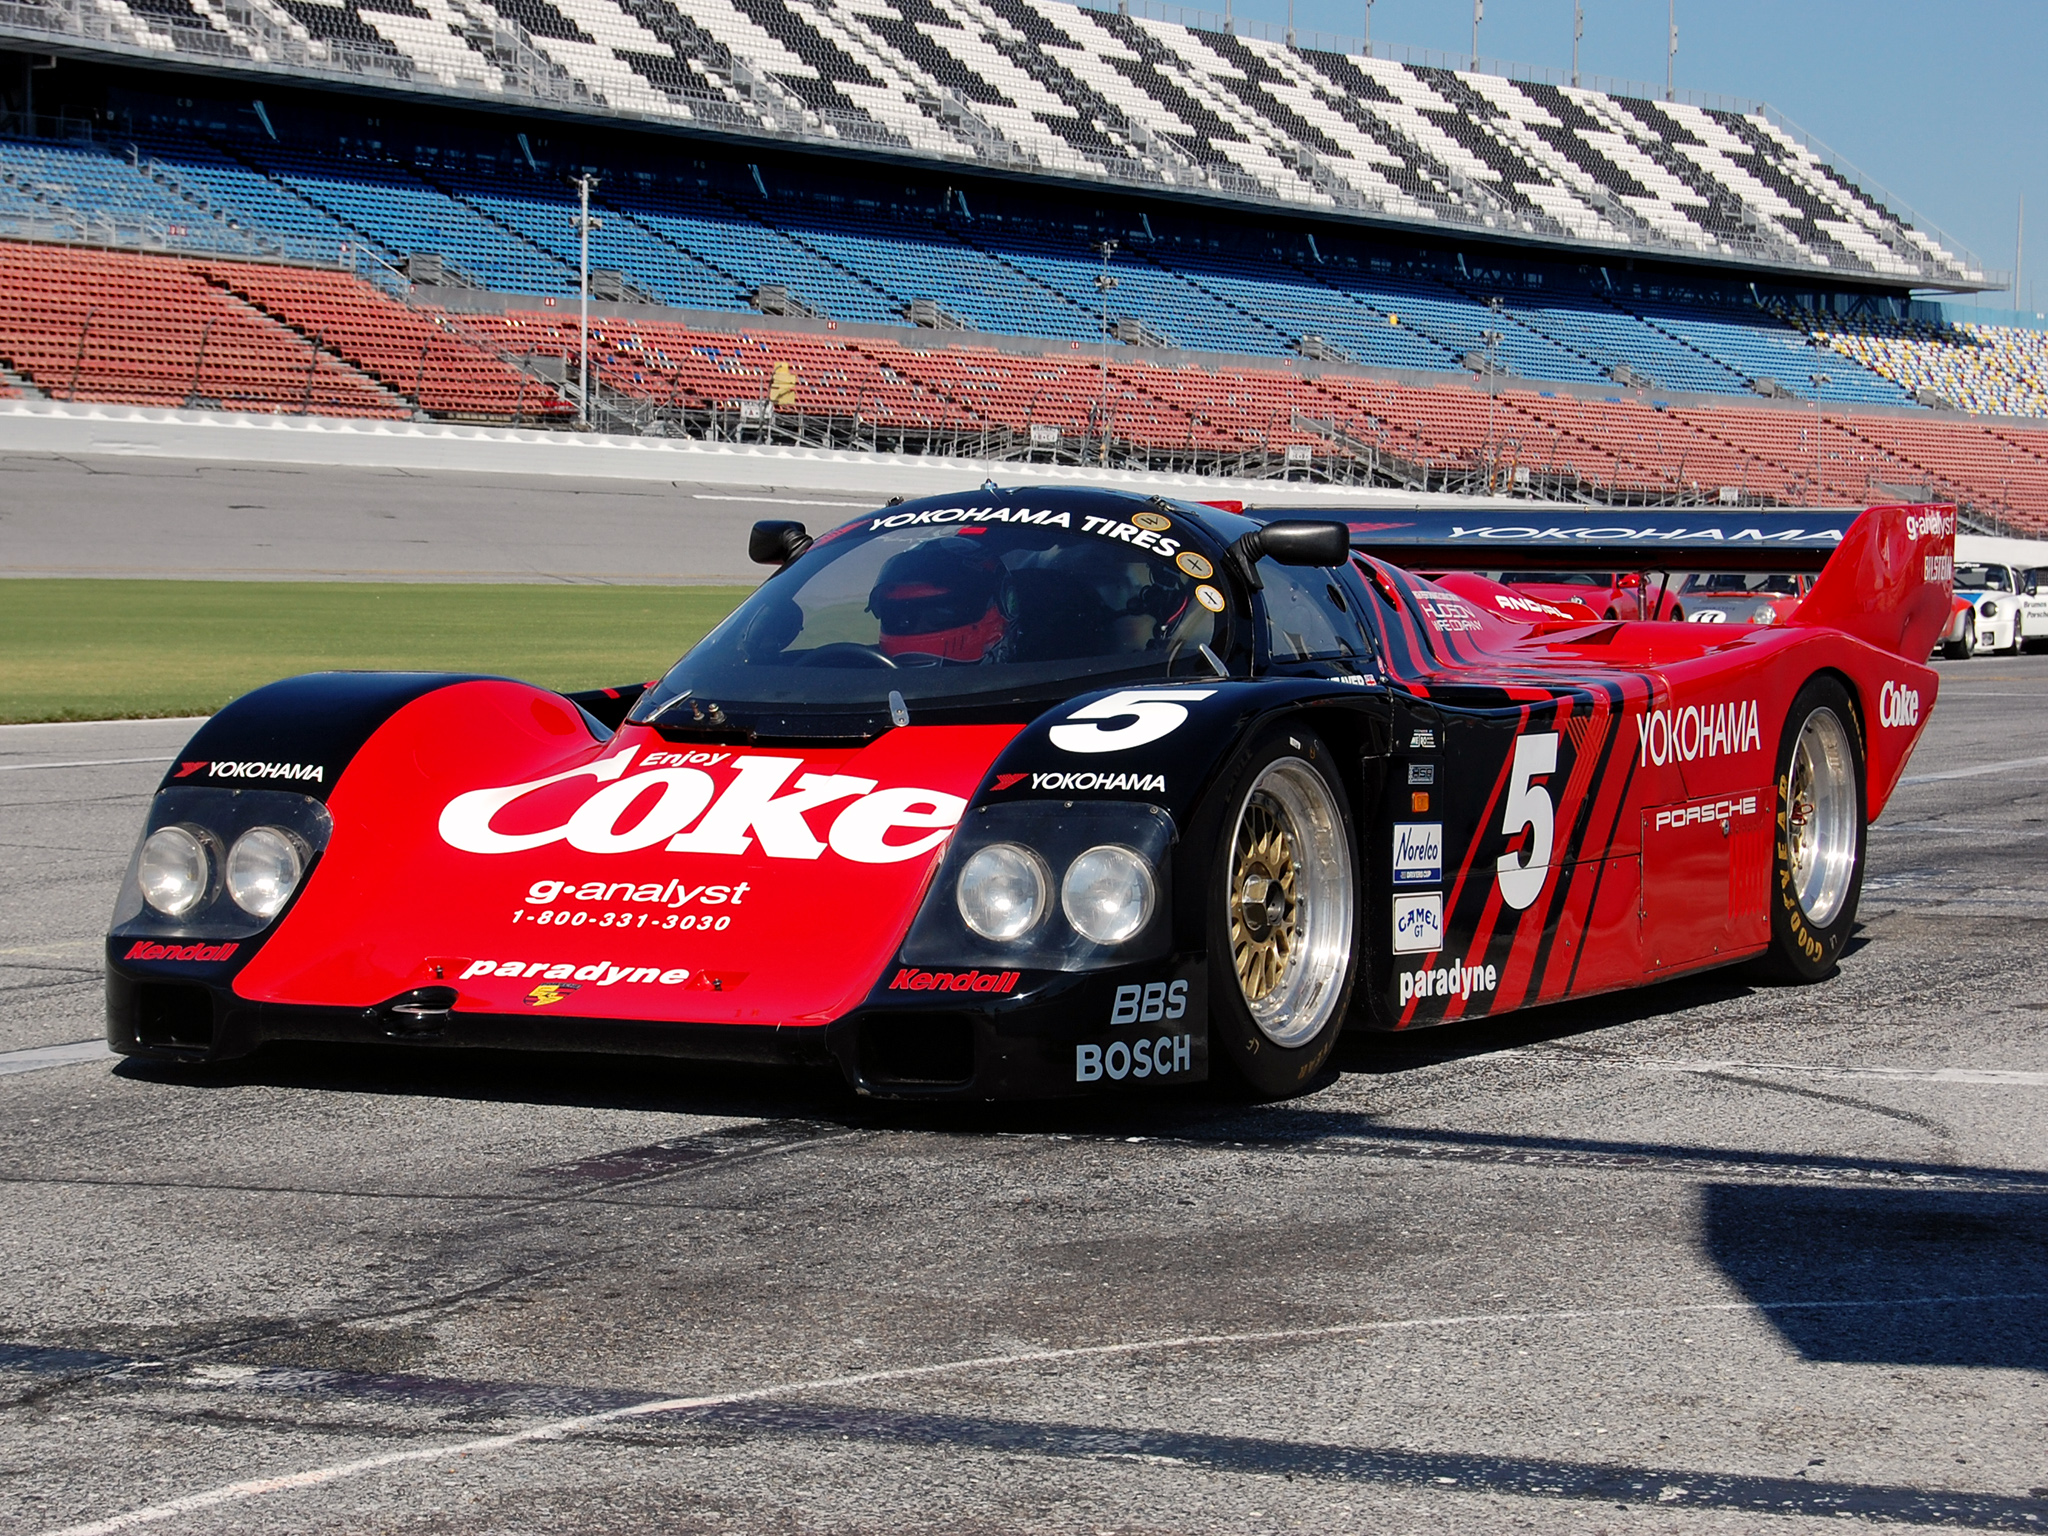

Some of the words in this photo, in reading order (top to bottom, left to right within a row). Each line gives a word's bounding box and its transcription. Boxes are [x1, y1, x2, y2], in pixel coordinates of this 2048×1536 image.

[869, 507, 1071, 531] YOKOHAMA
[1080, 515, 1181, 557] TIRES
[1447, 527, 1844, 540] YOKOHAMA
[1048, 689, 1219, 754] 5
[1879, 680, 1919, 728] Coke
[1636, 699, 1761, 767] YOKOHAMA
[208, 761, 324, 783] YOKOHAMA
[639, 750, 732, 767] Enjoy
[1030, 771, 1166, 792] YOKOHAMA
[438, 745, 969, 863] Coke
[1496, 732, 1559, 910] 5
[1655, 796, 1757, 831] PORSCHE
[1396, 827, 1439, 867] Norelco
[1777, 774, 1823, 963] GOODYEAR
[512, 909, 731, 931] 1-800-331-3030
[1398, 907, 1439, 932] CAMEL
[1414, 924, 1424, 937] GT
[123, 940, 240, 962] Kendall
[459, 959, 690, 986] paradyne
[889, 968, 1021, 993] Kendall
[1400, 959, 1497, 1005] paradyne
[1110, 980, 1190, 1025] BBS
[1076, 1034, 1191, 1082] BOSCH
